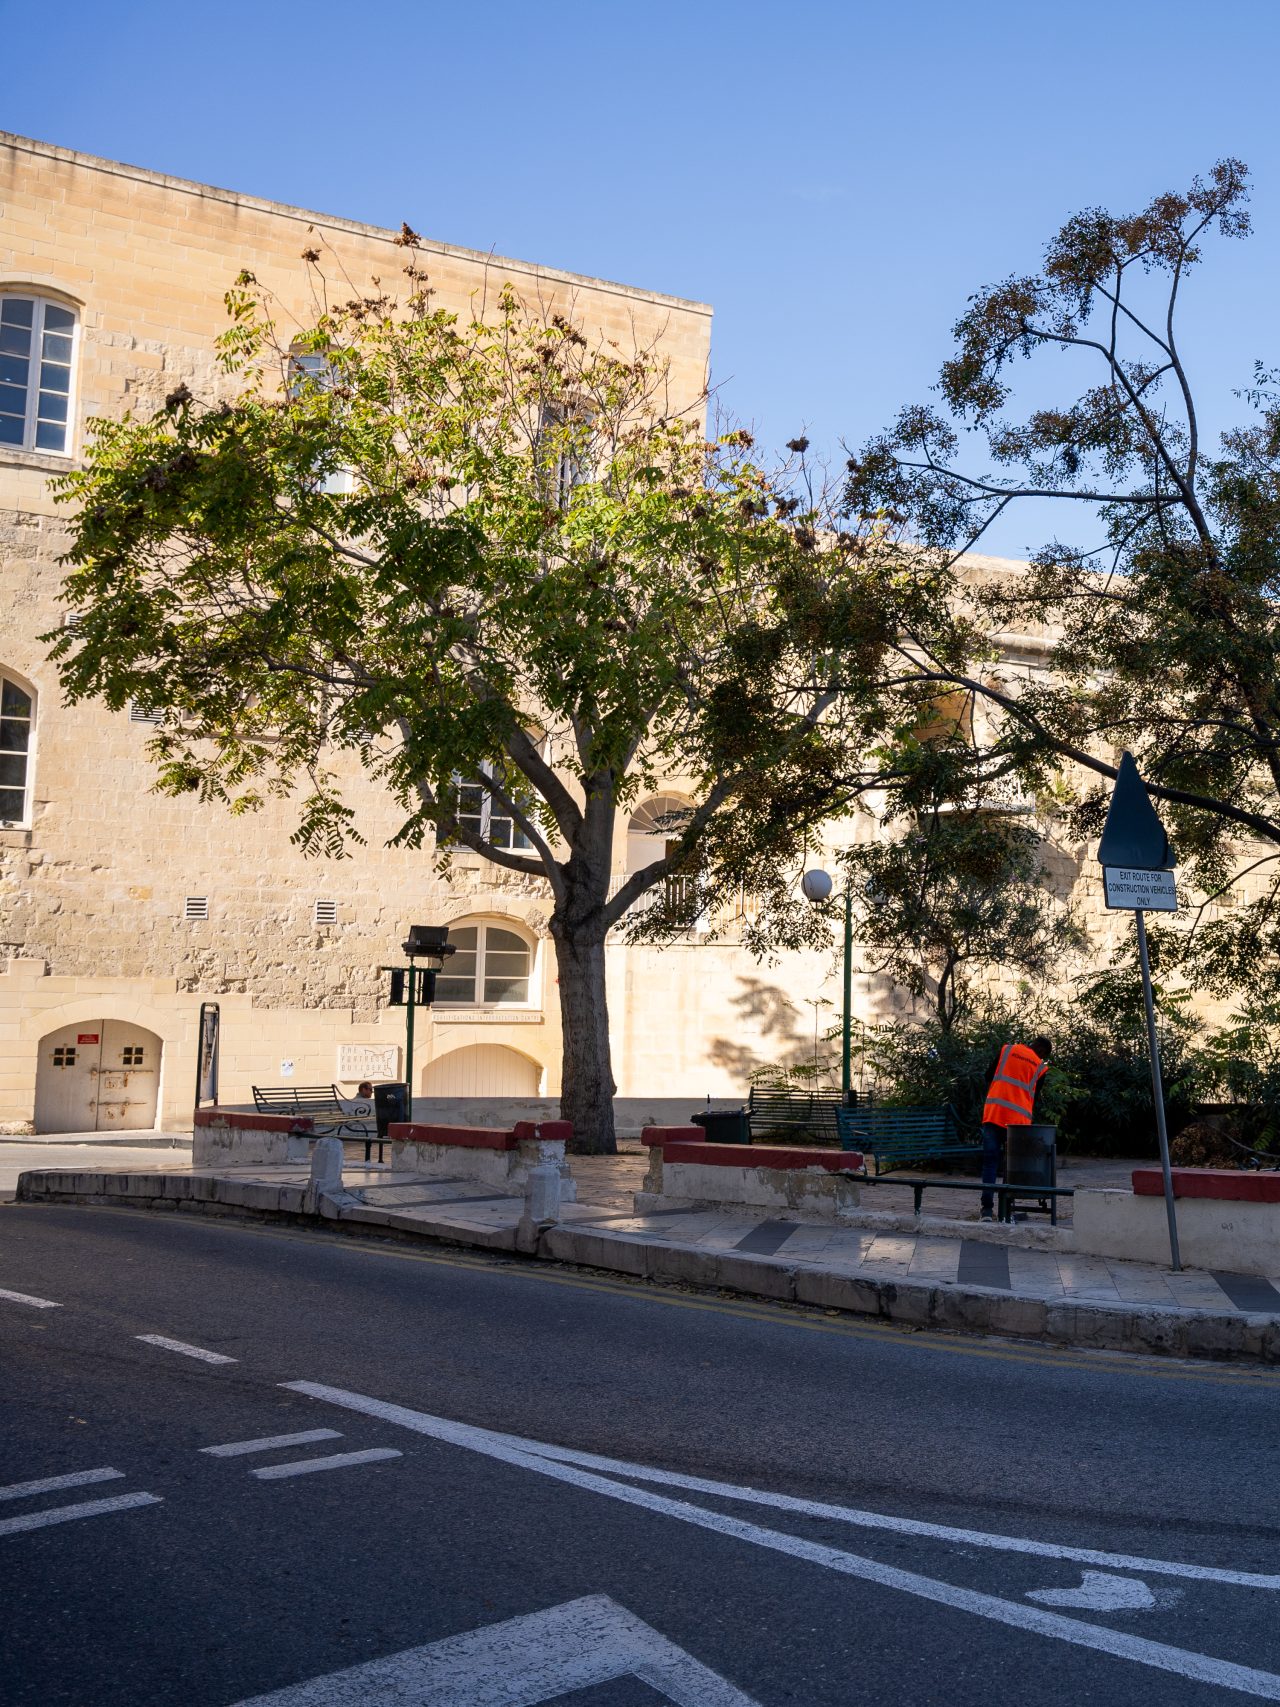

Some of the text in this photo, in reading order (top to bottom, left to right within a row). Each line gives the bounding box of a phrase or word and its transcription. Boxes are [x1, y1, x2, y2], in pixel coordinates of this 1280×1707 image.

[1120, 871, 1162, 882] EXIT ROUTE FOR
[1109, 883, 1174, 895] CONSTRUCTION VEHICLES
[1136, 897, 1150, 906] ONLY
